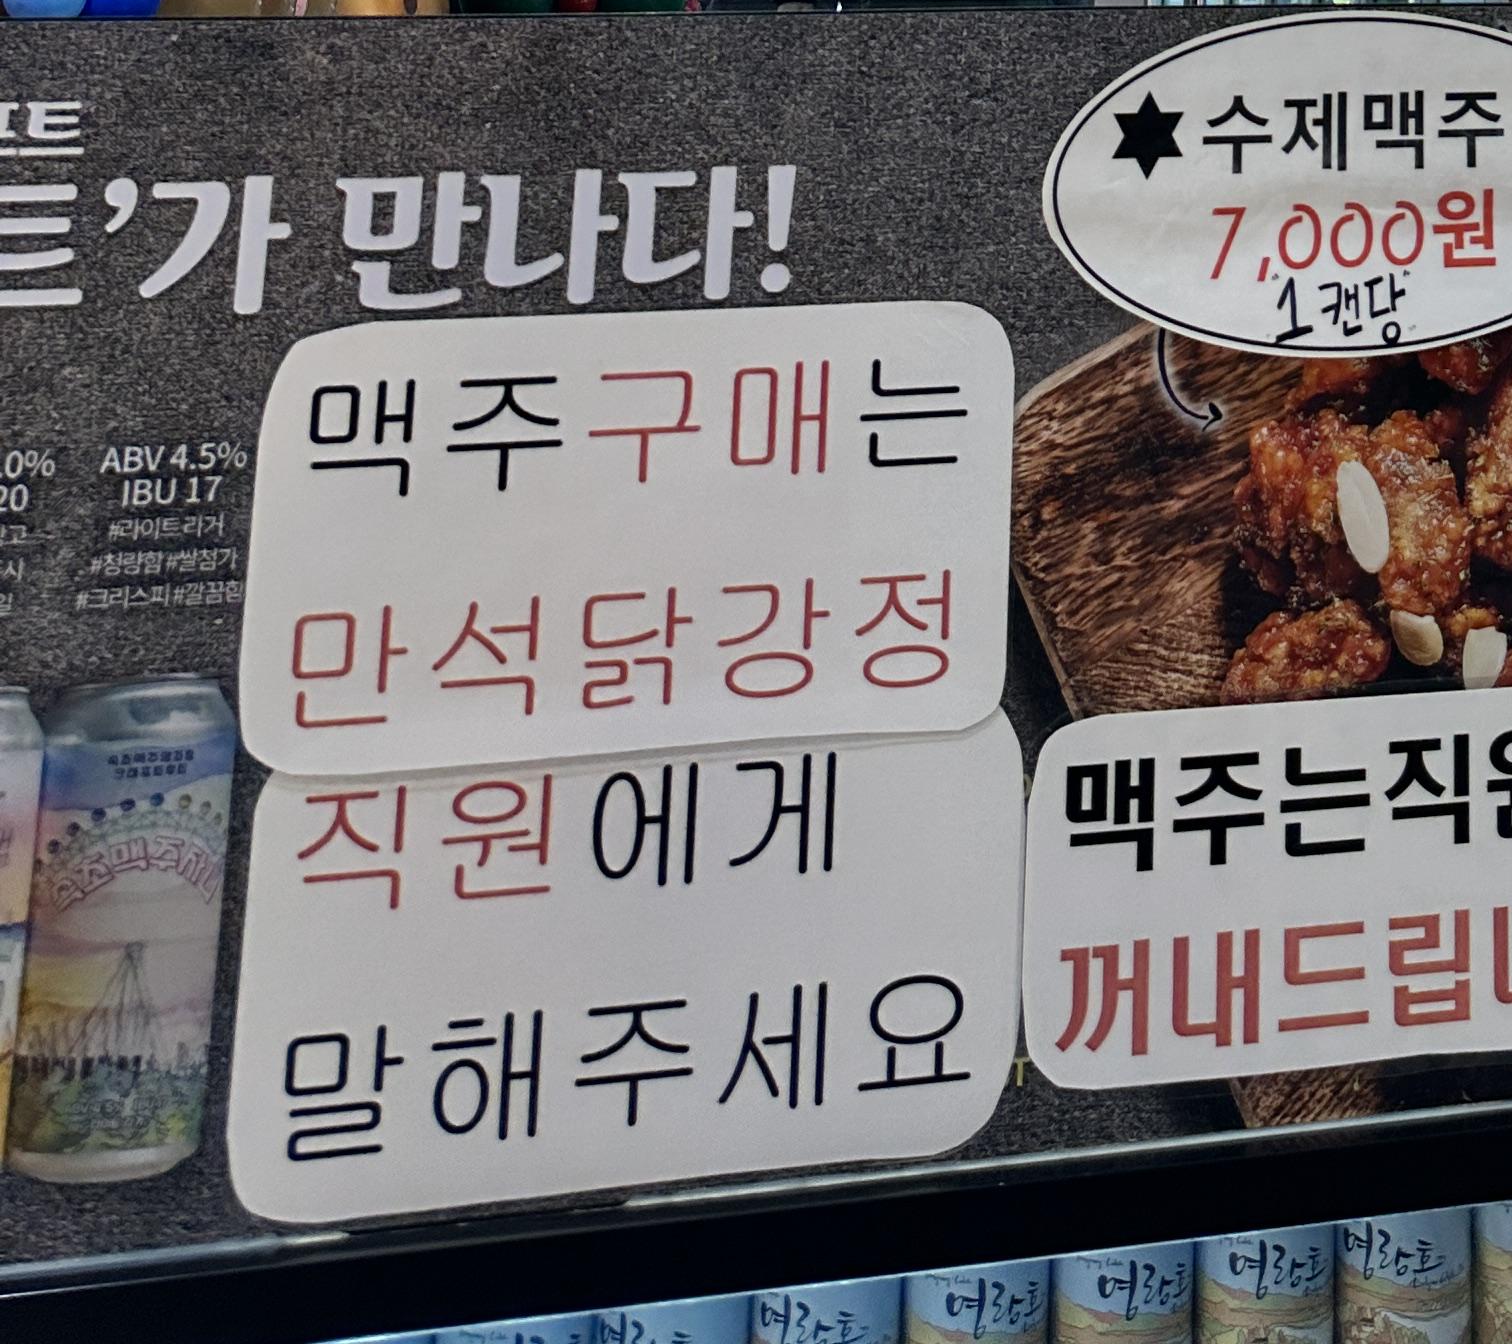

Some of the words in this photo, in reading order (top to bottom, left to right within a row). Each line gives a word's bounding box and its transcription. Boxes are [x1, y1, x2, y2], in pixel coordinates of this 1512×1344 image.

[1202, 90, 1504, 174] 수제맥주
[336, 164, 797, 309] 만나다!
[1210, 188, 1497, 282] 7,000원
[101, 445, 165, 474] ABV
[169, 441, 248, 471] 4.5%
[122, 478, 177, 507] IBU
[186, 475, 223, 503] 17
[76, 585, 170, 611] #크리스피
[90, 548, 163, 576] #청량함
[167, 546, 239, 573] #쌀첨가
[291, 568, 953, 729] 만석닭강정
[297, 752, 837, 910] 직원에게
[284, 974, 971, 1162] 말해주세요
